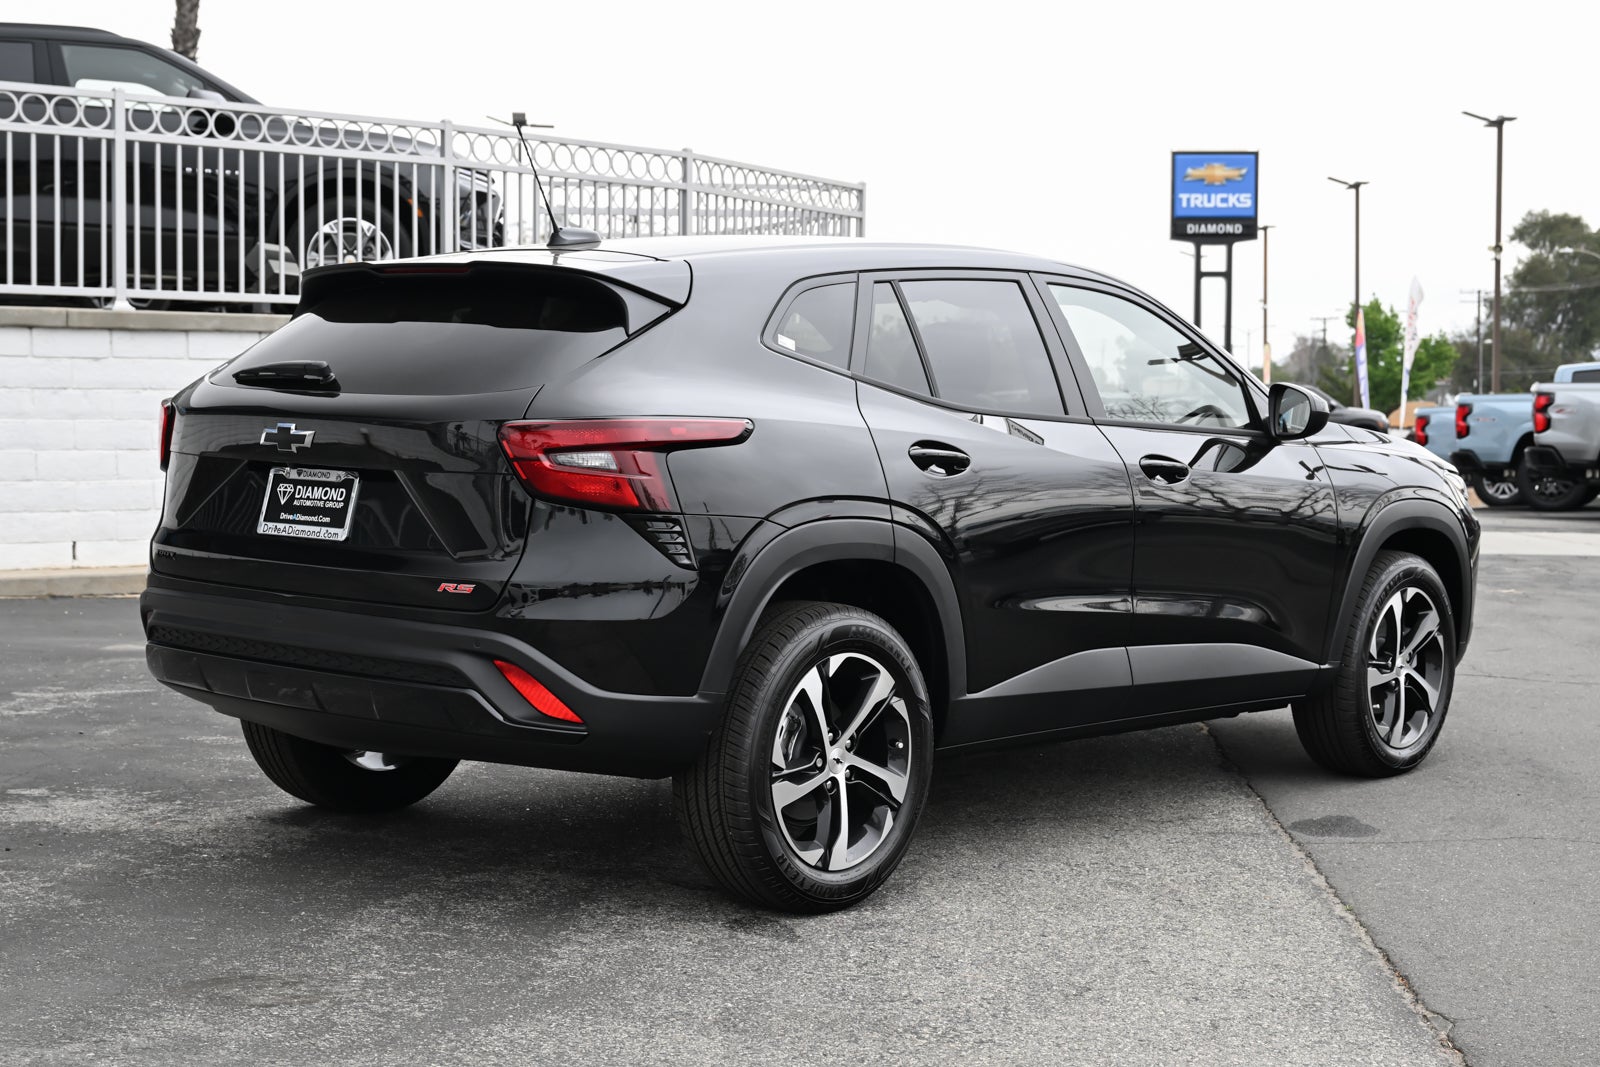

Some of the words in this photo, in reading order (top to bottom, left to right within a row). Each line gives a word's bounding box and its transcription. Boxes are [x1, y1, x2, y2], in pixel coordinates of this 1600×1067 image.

[1178, 193, 1252, 208] TRUCKS
[1186, 223, 1243, 234] DIAMOND
[302, 469, 331, 479] DIAMOND
[295, 485, 346, 501] DIAMOND
[293, 499, 325, 508] AUTOMOTIVE
[325, 500, 344, 509] GROUP
[262, 523, 338, 538] DriveADiamond.com
[437, 583, 476, 594] RS
